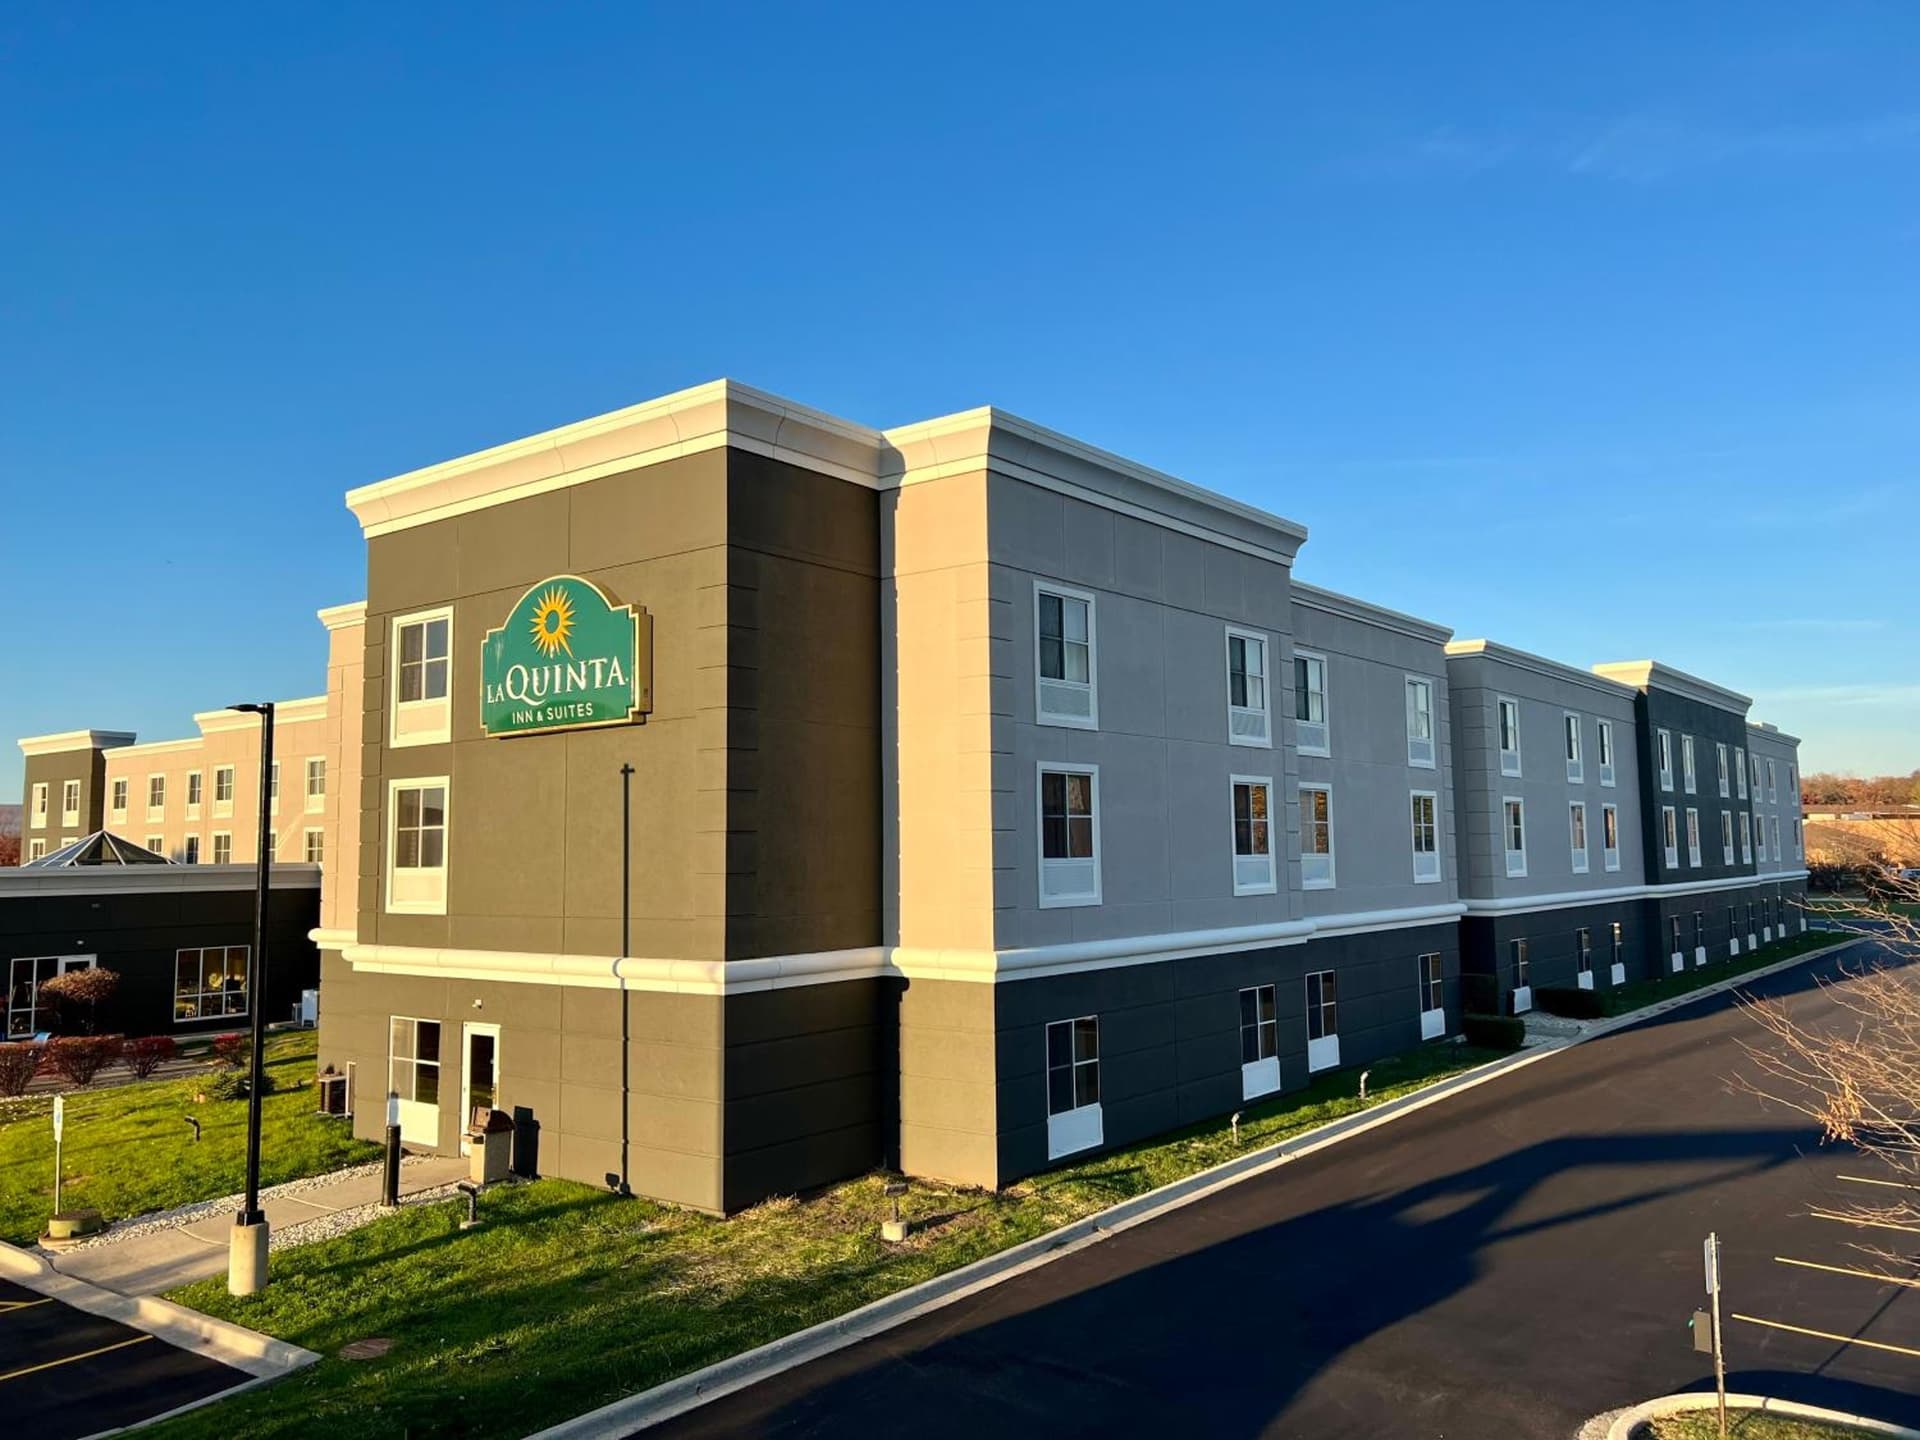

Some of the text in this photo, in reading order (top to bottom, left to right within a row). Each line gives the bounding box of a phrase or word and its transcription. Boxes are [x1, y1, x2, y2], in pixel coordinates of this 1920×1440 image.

[487, 655, 626, 706] LA QUINTA
[512, 702, 593, 725] INN & SUITES
